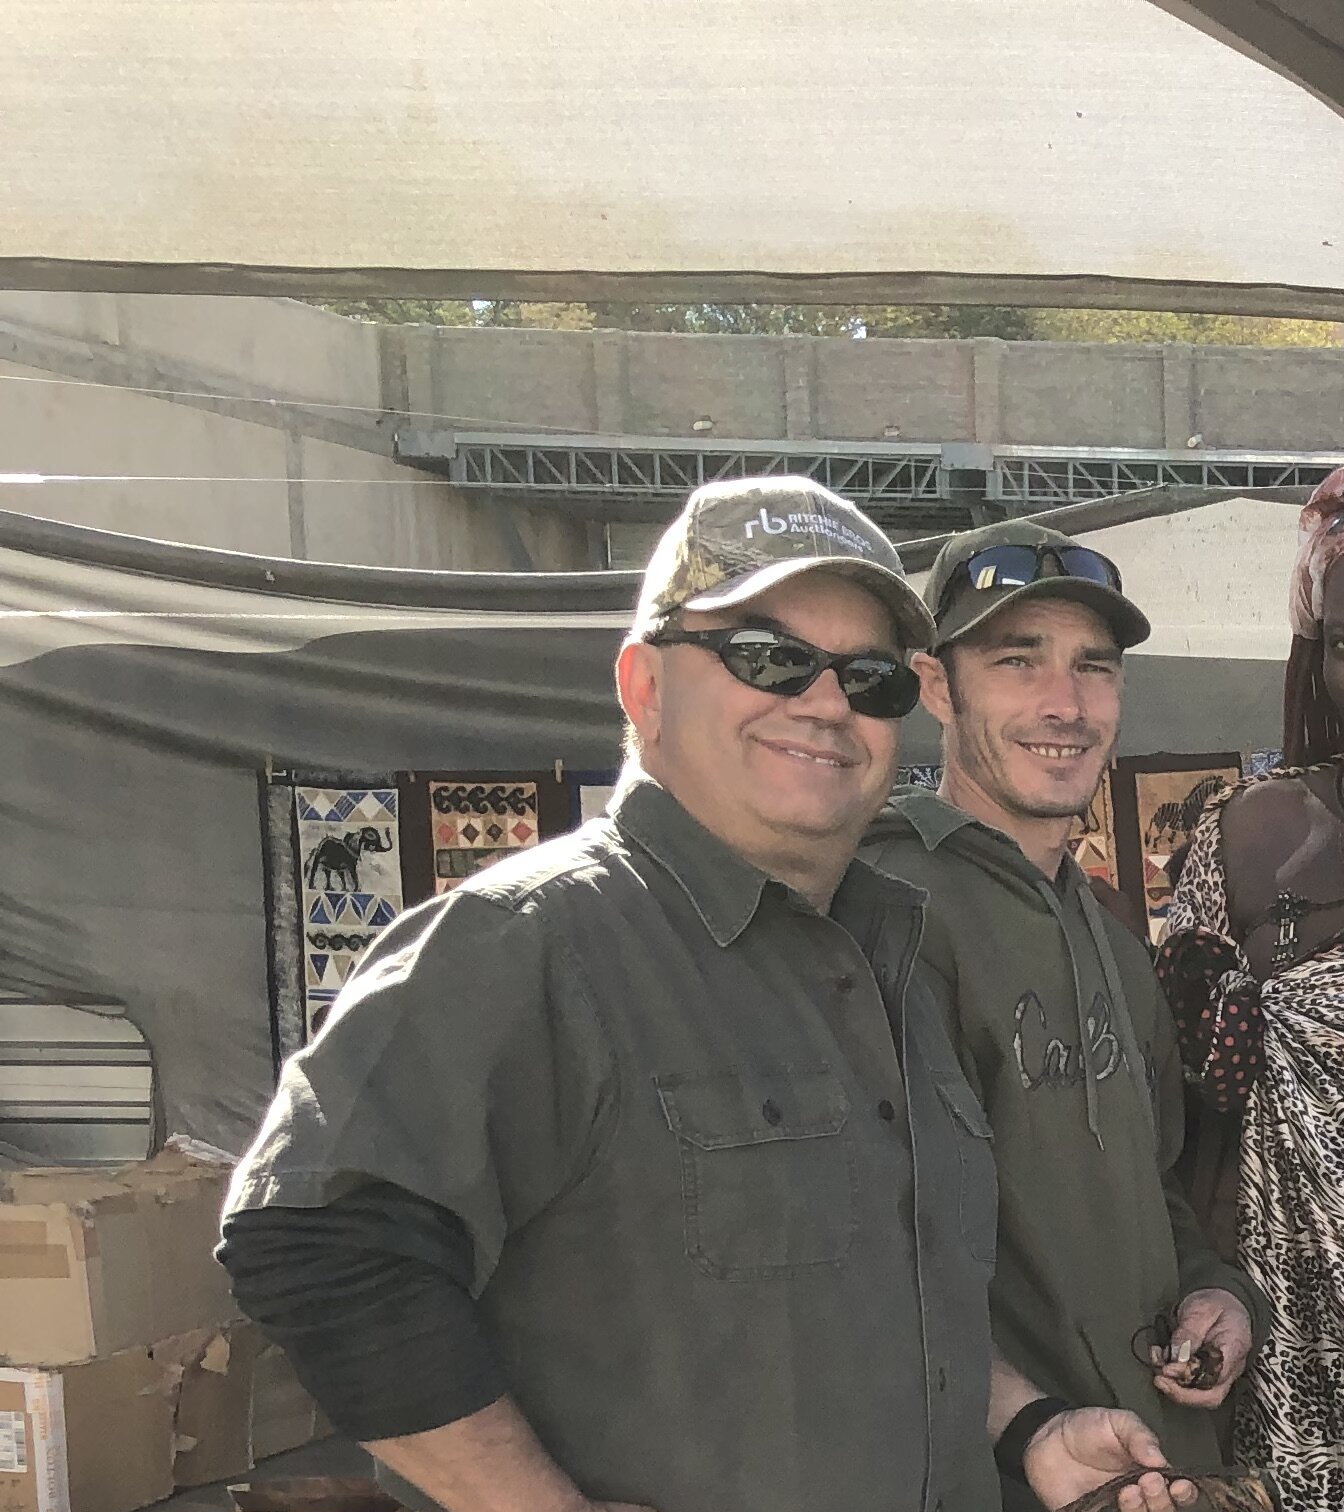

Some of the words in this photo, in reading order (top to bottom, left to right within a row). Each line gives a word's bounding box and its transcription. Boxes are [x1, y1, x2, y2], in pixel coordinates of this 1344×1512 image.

[743, 507, 788, 539] rb
[787, 512, 839, 531] RITCHIE
[790, 523, 864, 553] Auctioneers
